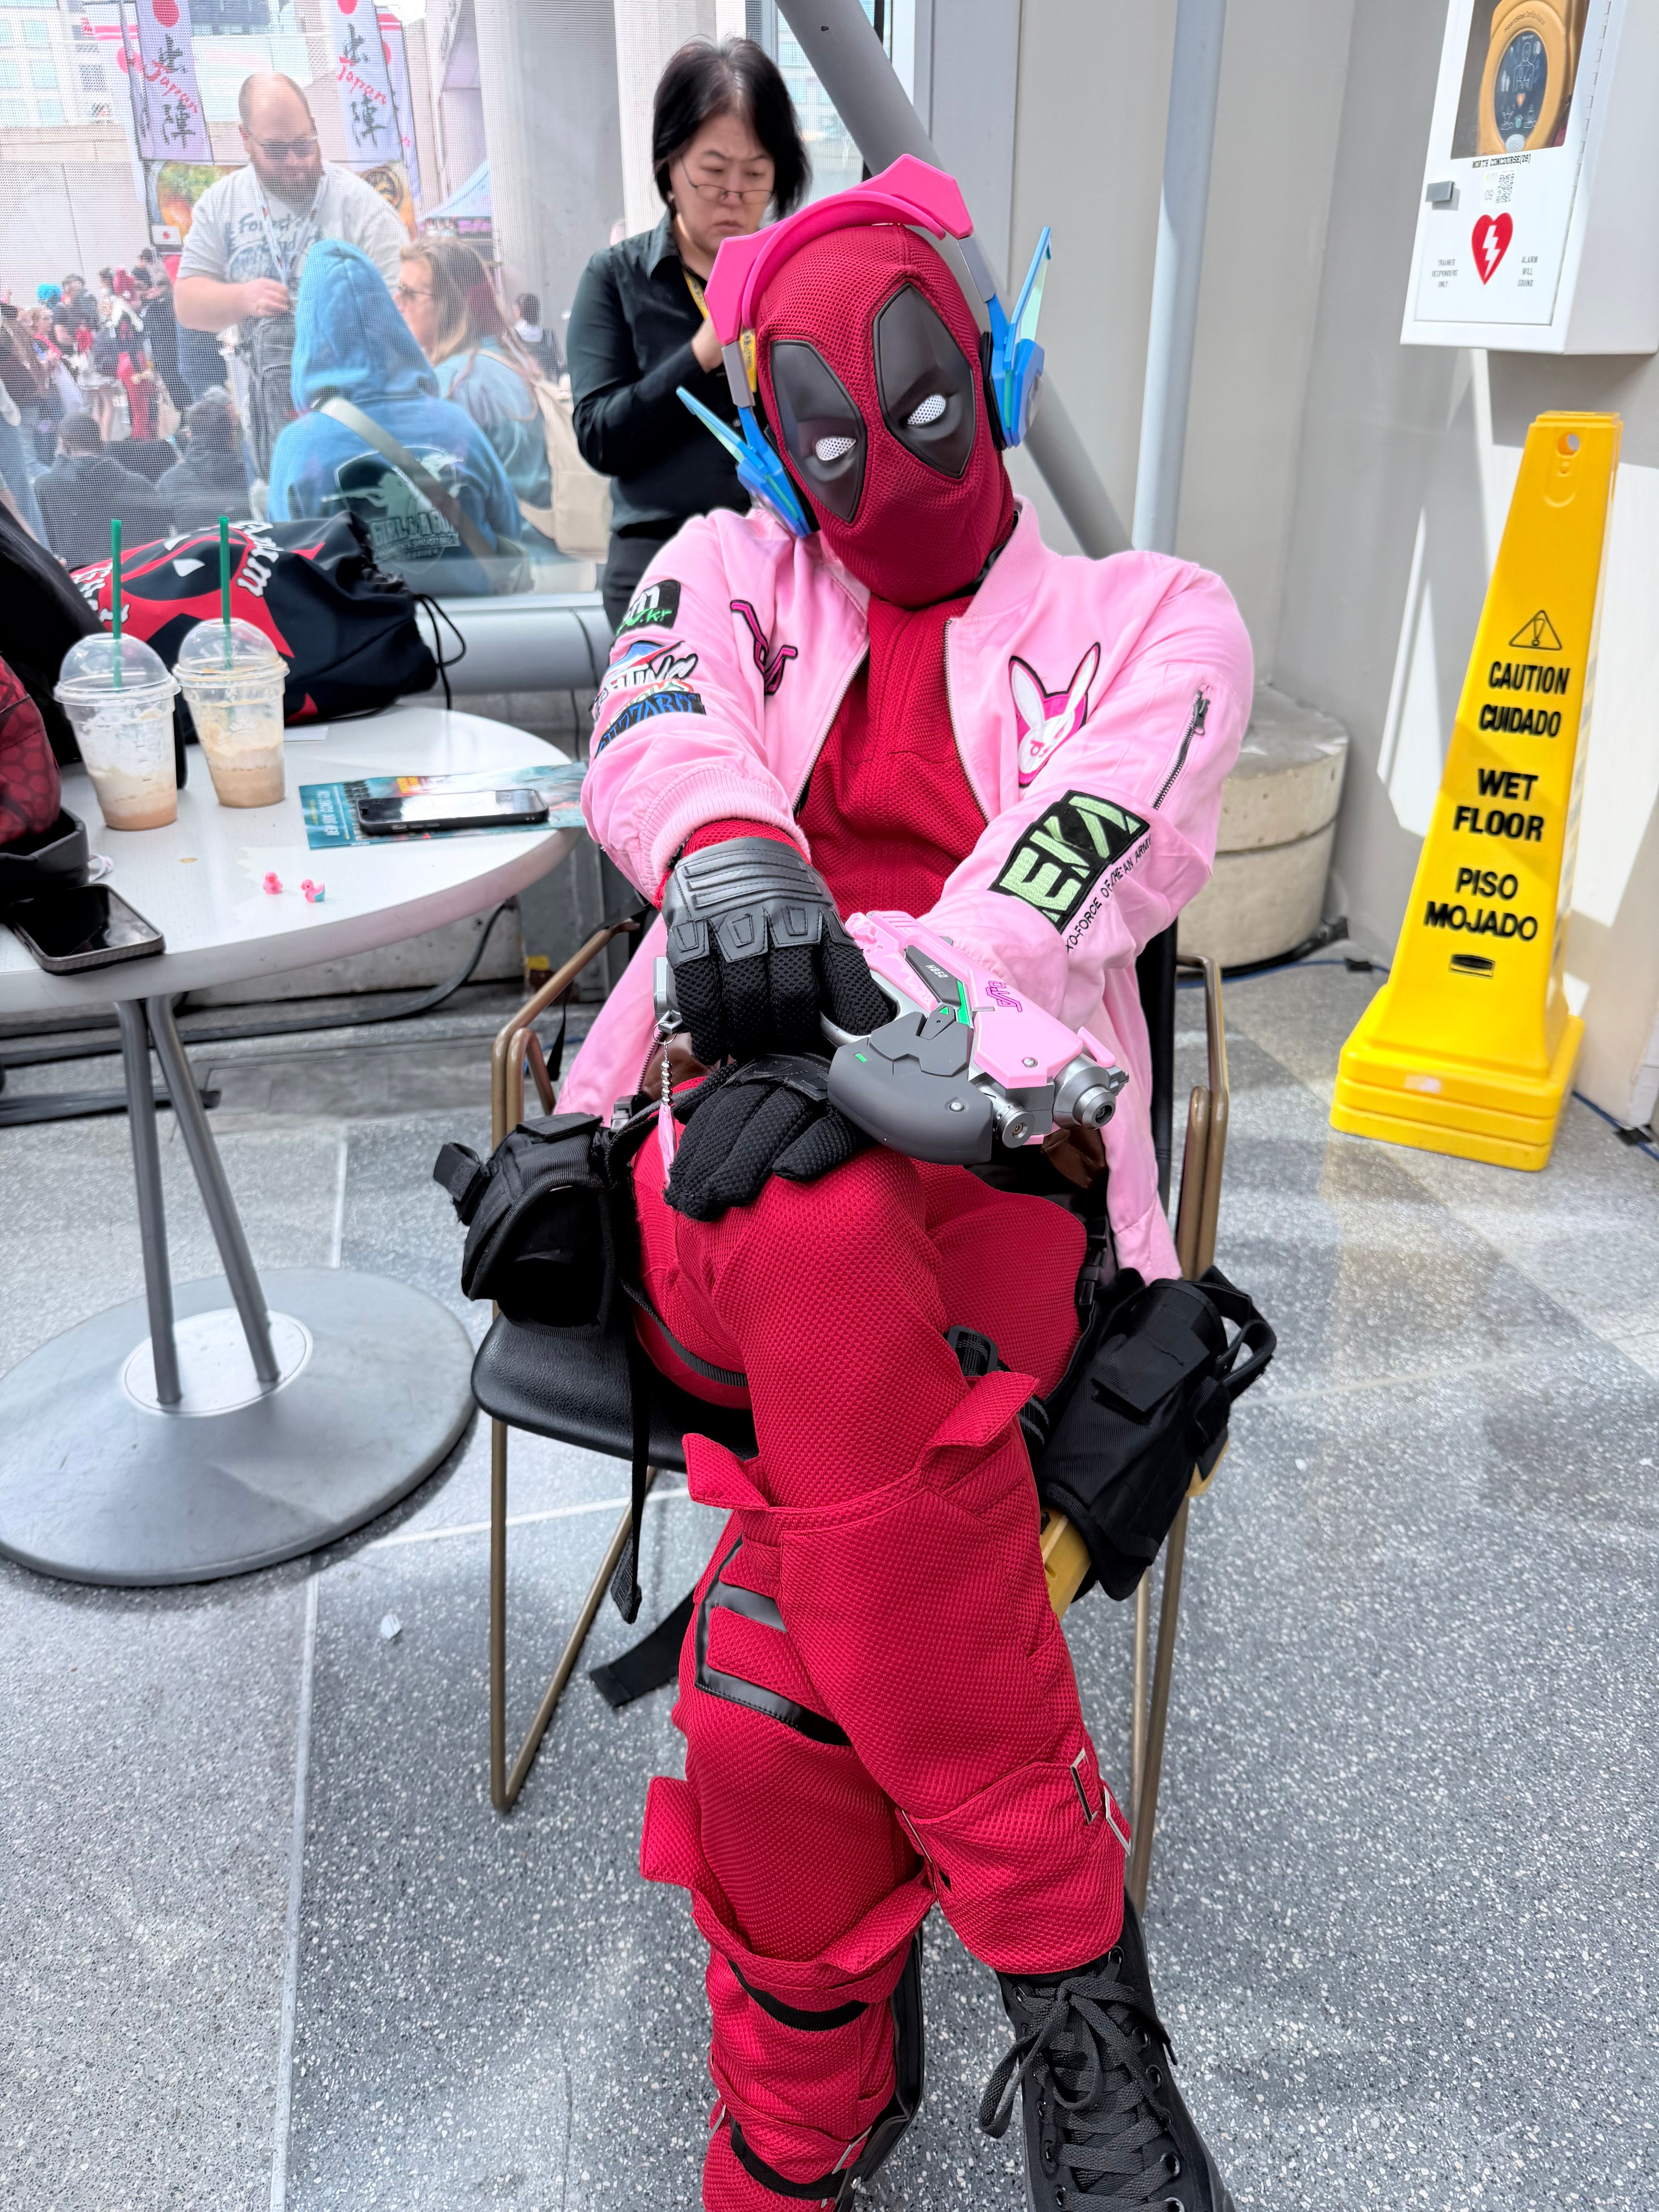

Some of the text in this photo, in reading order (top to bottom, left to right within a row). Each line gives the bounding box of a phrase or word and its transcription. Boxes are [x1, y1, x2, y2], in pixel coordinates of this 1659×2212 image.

[1488, 661, 1570, 696] CAUTION
[1479, 703, 1561, 738] CUIDADO
[1477, 768, 1539, 802] WET
[1452, 805, 1544, 842] FLOOR
[1455, 867, 1518, 901] PISO
[1065, 897, 1102, 954] XO-FORCE
[1424, 901, 1539, 942] MOJADO
